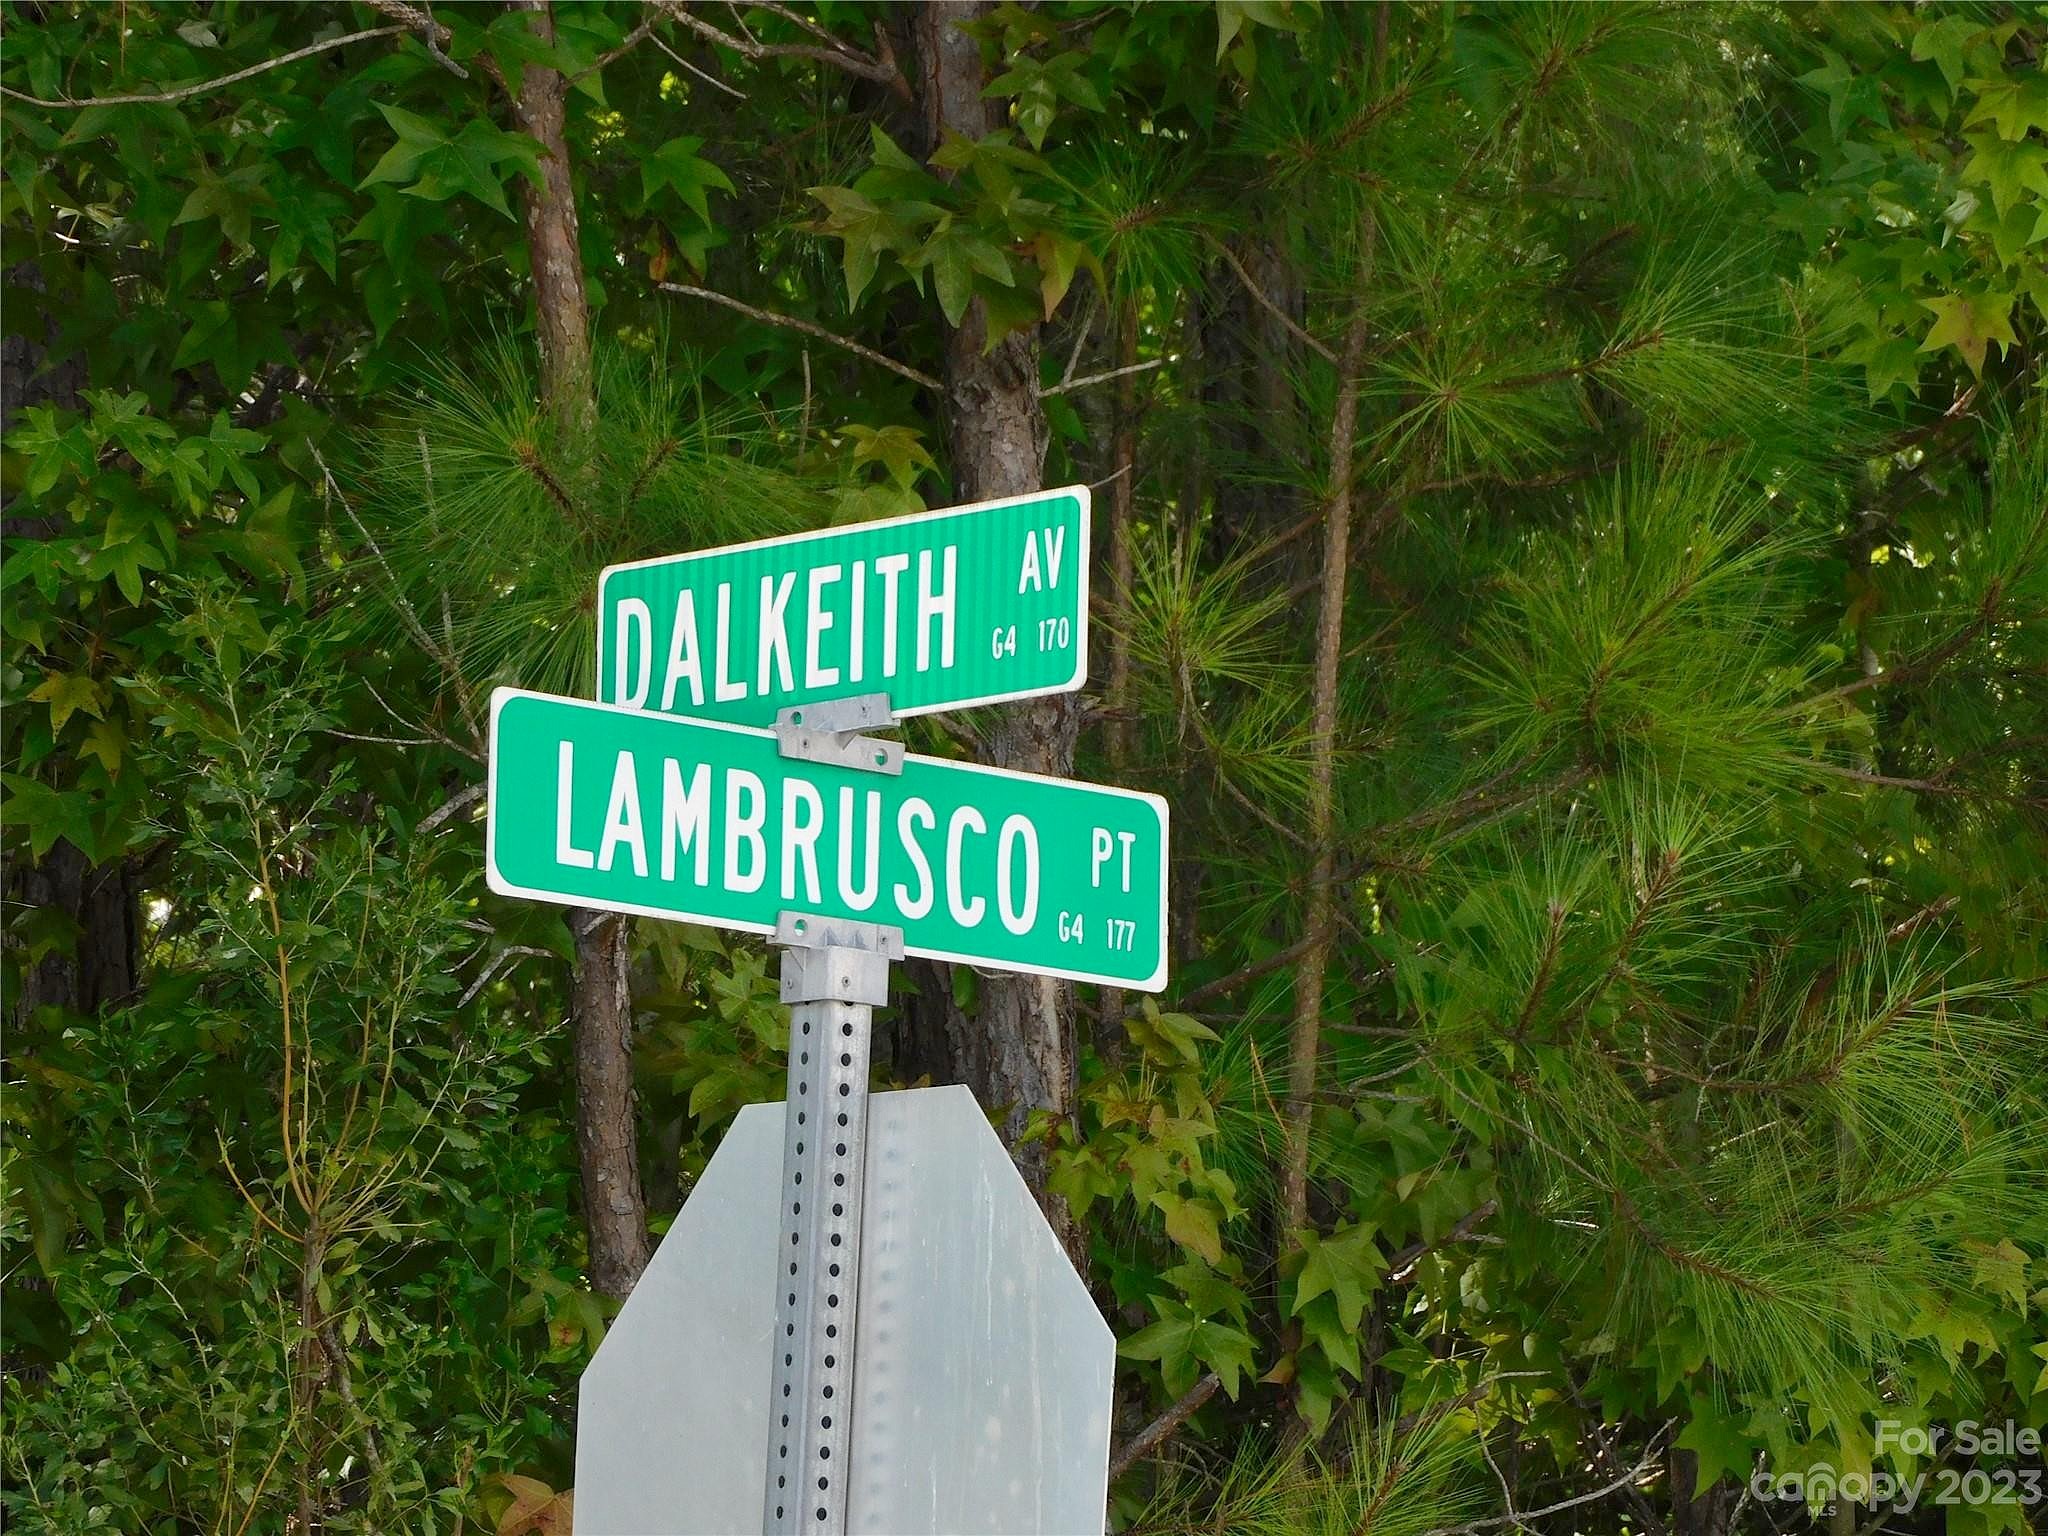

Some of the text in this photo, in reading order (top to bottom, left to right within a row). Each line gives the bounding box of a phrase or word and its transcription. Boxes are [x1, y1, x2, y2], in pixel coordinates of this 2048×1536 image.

[615, 525, 1065, 711] DALKEITH AV
[992, 617, 1070, 660] G4 170
[555, 739, 1136, 936] LAMBRUSCO PT
[1058, 911, 1136, 953] G4 177
